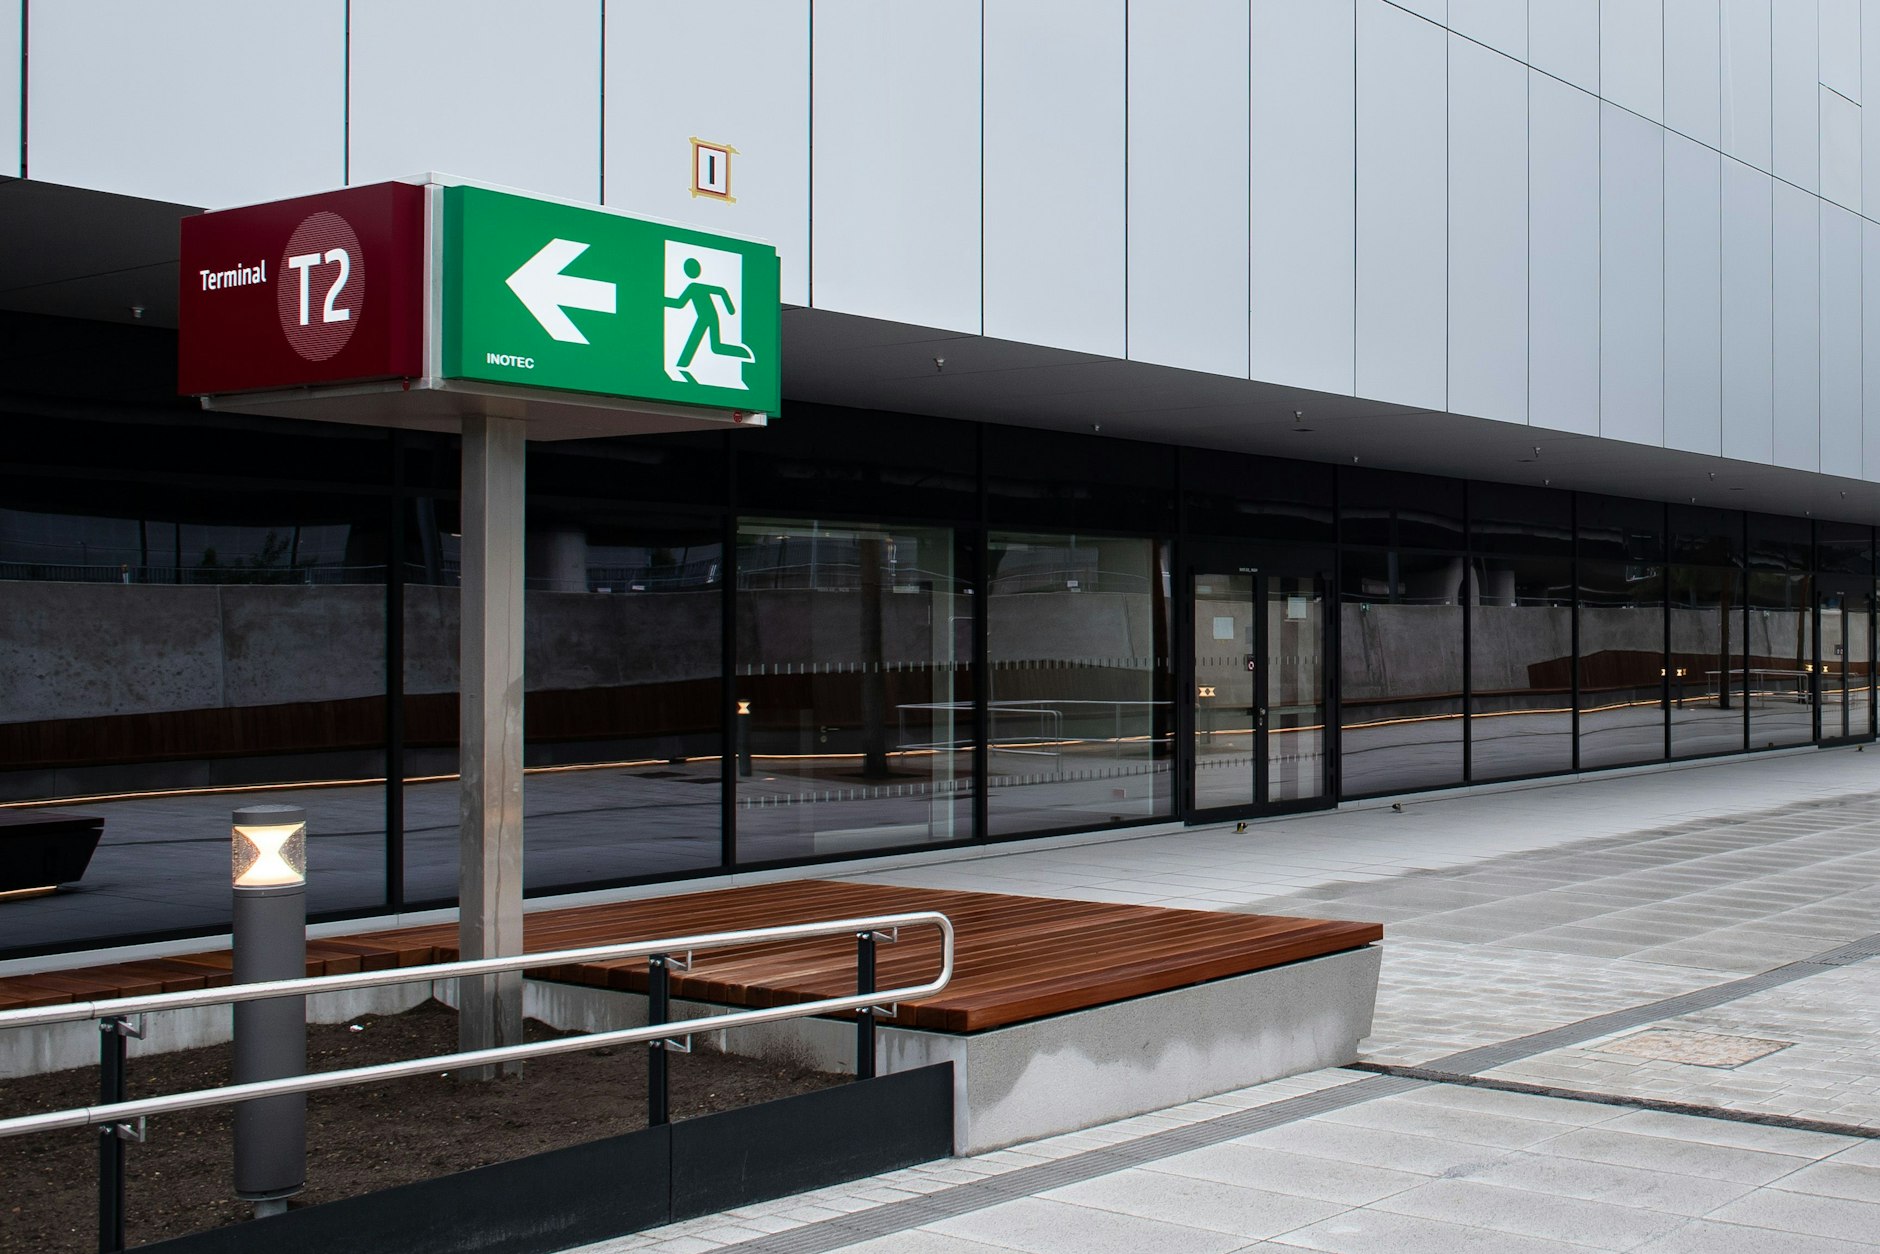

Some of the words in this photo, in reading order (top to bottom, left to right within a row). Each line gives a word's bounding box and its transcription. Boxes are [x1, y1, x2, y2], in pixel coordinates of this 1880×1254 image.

[199, 259, 267, 291] Terminal
[288, 248, 350, 325] T2
[486, 352, 535, 370] INOTEC
